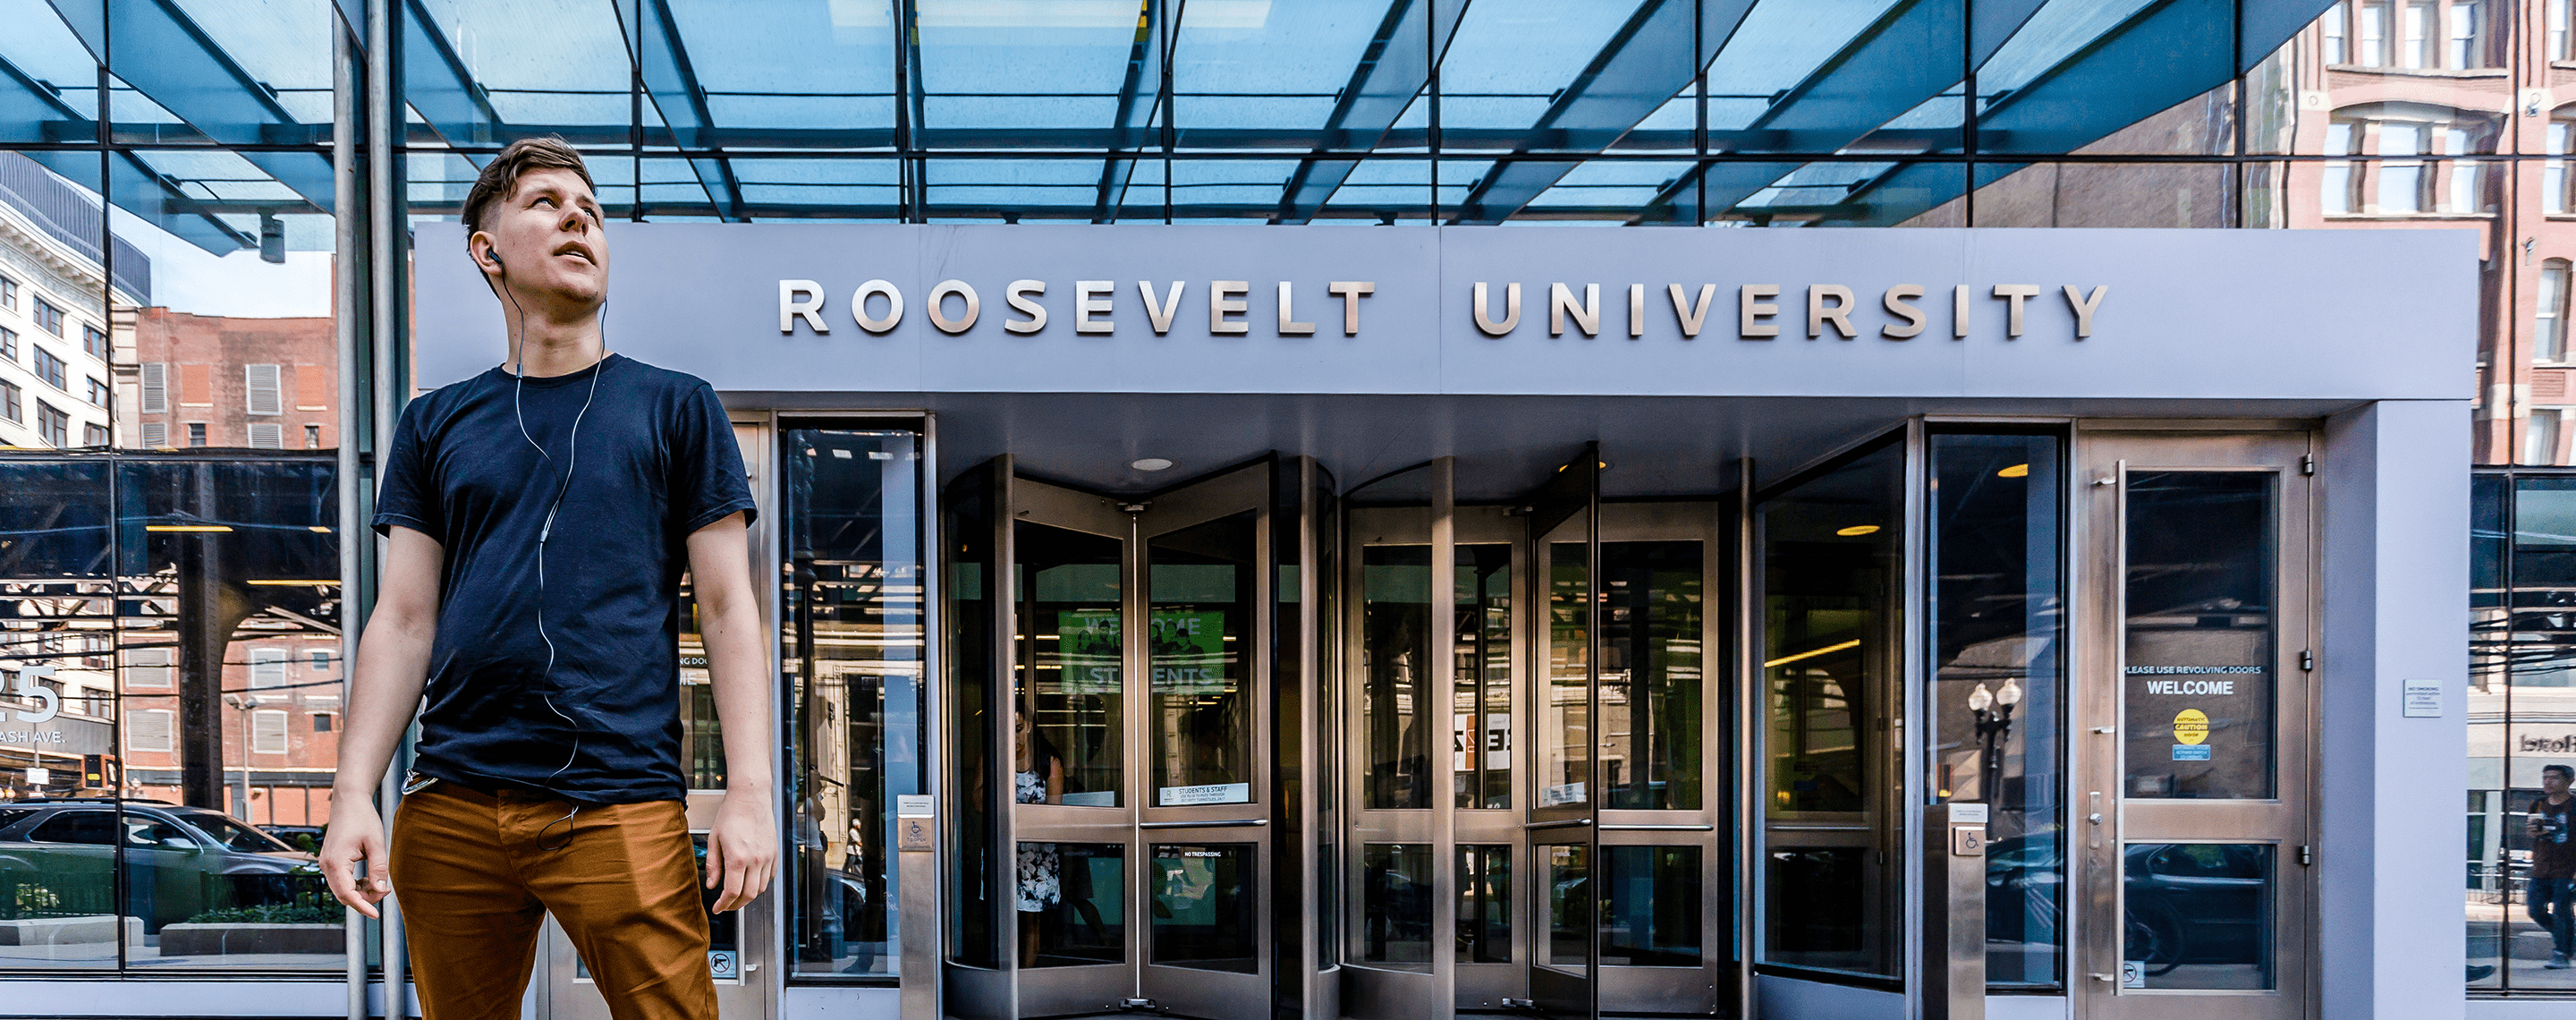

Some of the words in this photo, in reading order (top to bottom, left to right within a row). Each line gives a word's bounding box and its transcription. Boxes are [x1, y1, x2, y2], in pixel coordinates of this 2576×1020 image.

[779, 279, 1375, 335] ROOSEVELT
[1473, 282, 2109, 338] UNIVERSITY
[1085, 617, 1200, 635] WEOME
[1090, 667, 1213, 684] STENTS
[2157, 666, 2173, 674] USE
[2177, 666, 2227, 674] REVOLVING
[2229, 666, 2261, 674] DOORS
[0, 666, 59, 723] 5
[2147, 681, 2233, 694] WELCOME
[33, 731, 66, 743] AVE.
